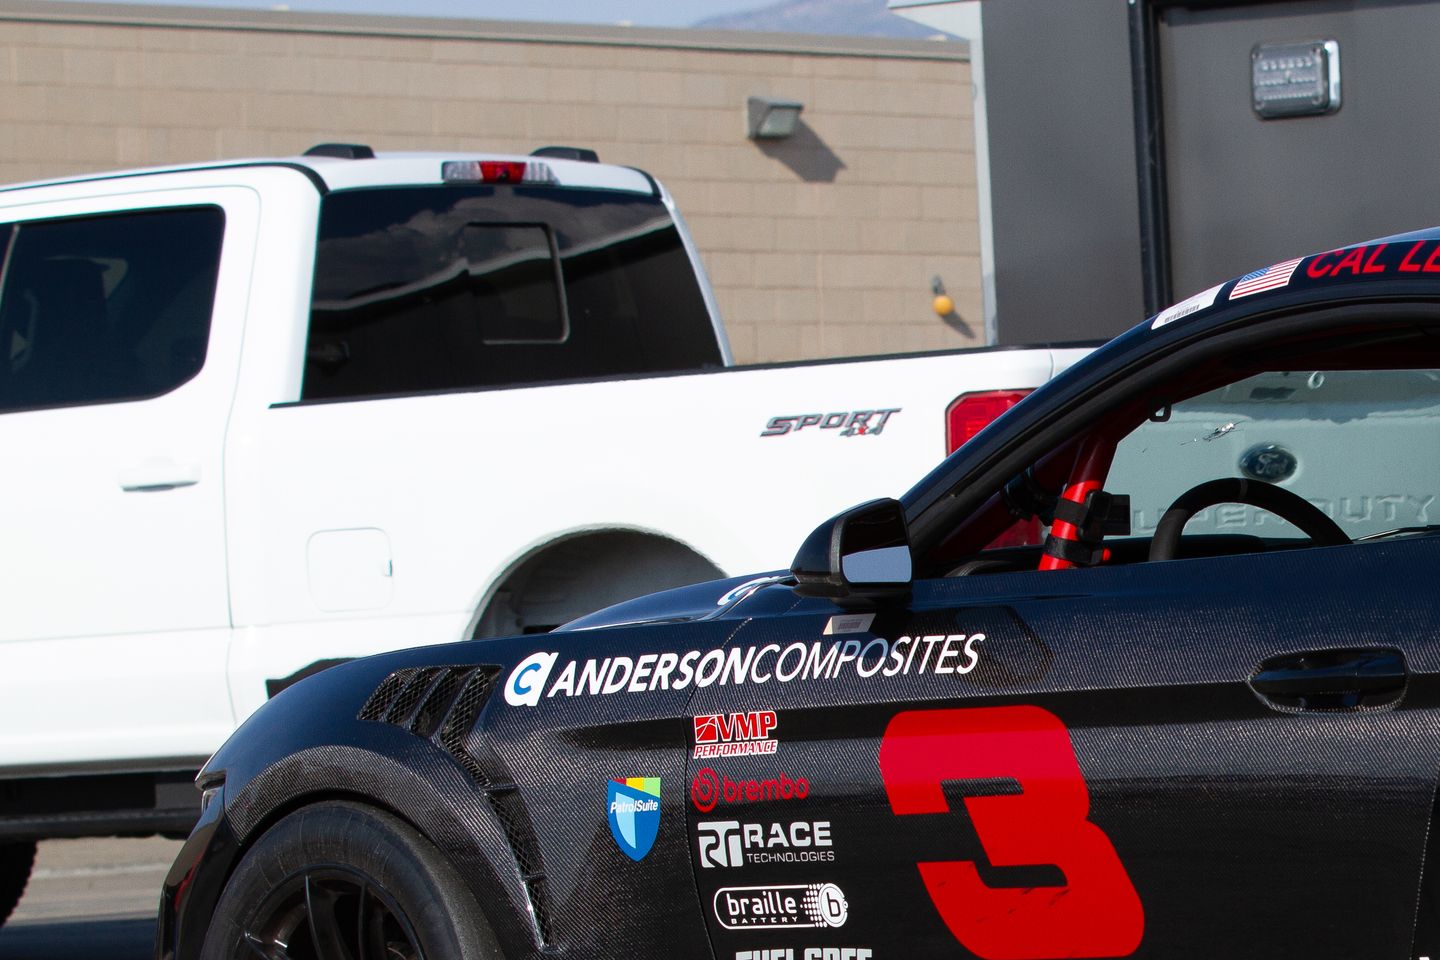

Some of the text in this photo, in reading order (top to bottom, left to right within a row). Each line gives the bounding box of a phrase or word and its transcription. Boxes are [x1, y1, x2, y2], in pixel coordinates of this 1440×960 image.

[1306, 242, 1387, 279] CAL
[760, 408, 903, 437] SPORT
[715, 711, 777, 741] VMP
[693, 740, 778, 759] PERFORMANCE
[723, 772, 810, 802] brembo
[610, 799, 659, 814] PatrolSuite
[743, 821, 833, 848] RACE
[879, 705, 1145, 960] 3
[746, 851, 835, 864] TECHNOLOGIES
[726, 891, 797, 915] braille
[731, 916, 798, 925] BATTERY
